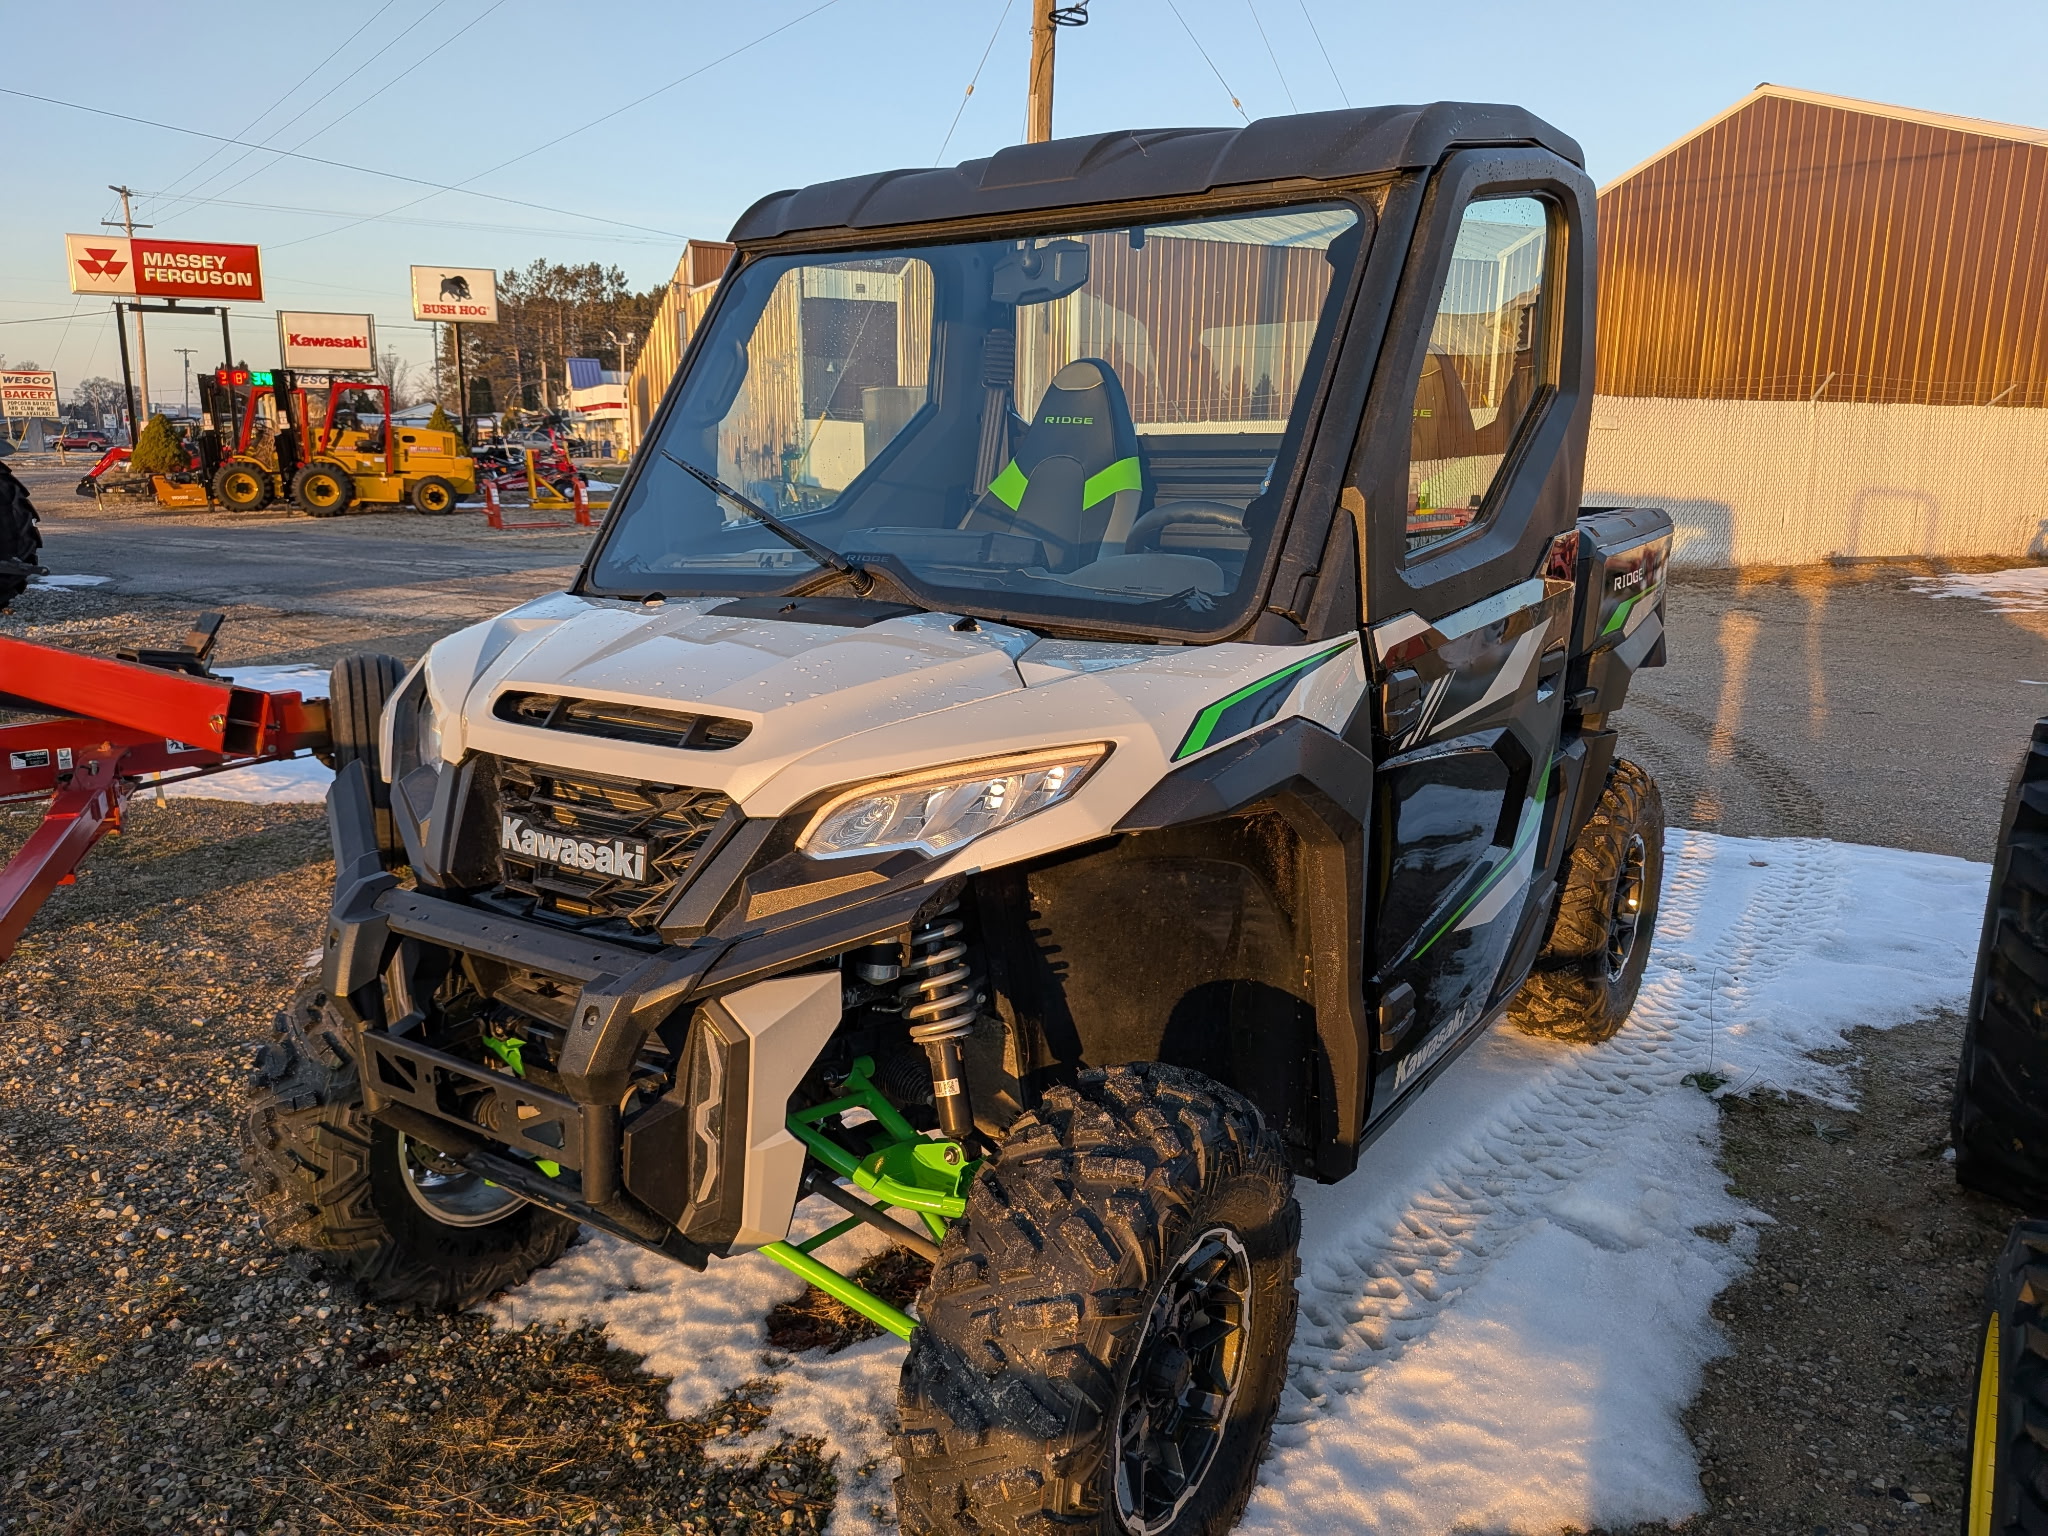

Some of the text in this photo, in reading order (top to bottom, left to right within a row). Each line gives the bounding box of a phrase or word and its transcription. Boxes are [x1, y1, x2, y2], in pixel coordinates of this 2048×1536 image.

[142, 251, 227, 270] MASSEY
[144, 267, 253, 287] FERGUSON
[422, 303, 487, 316] BUSH HOG
[288, 333, 368, 349] Kawasaki
[3, 376, 51, 384] WESCO
[4, 391, 53, 399] BAKERY
[1044, 416, 1094, 425] RIDGE
[846, 554, 890, 563] RIDGE
[1613, 567, 1644, 592] RIDGE
[501, 815, 645, 881] Kawasaki
[1392, 1000, 1468, 1092] Kawasaki
